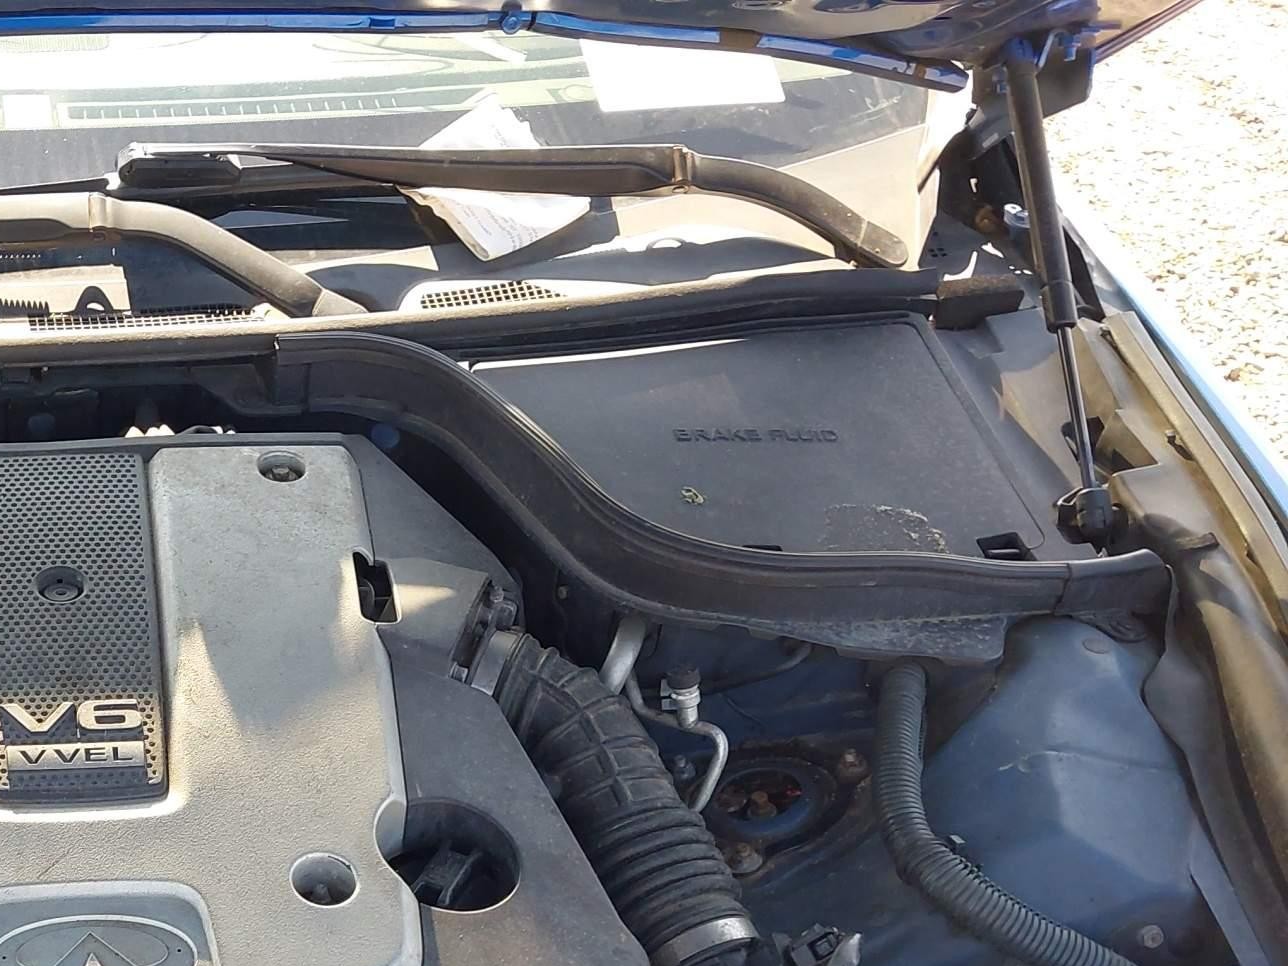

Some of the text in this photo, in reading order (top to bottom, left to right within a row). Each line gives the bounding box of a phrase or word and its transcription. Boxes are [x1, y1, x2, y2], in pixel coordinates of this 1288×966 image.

[674, 428, 839, 442] BRAKE FLUID
[0, 698, 143, 733] V6
[19, 746, 133, 765] VVEL
